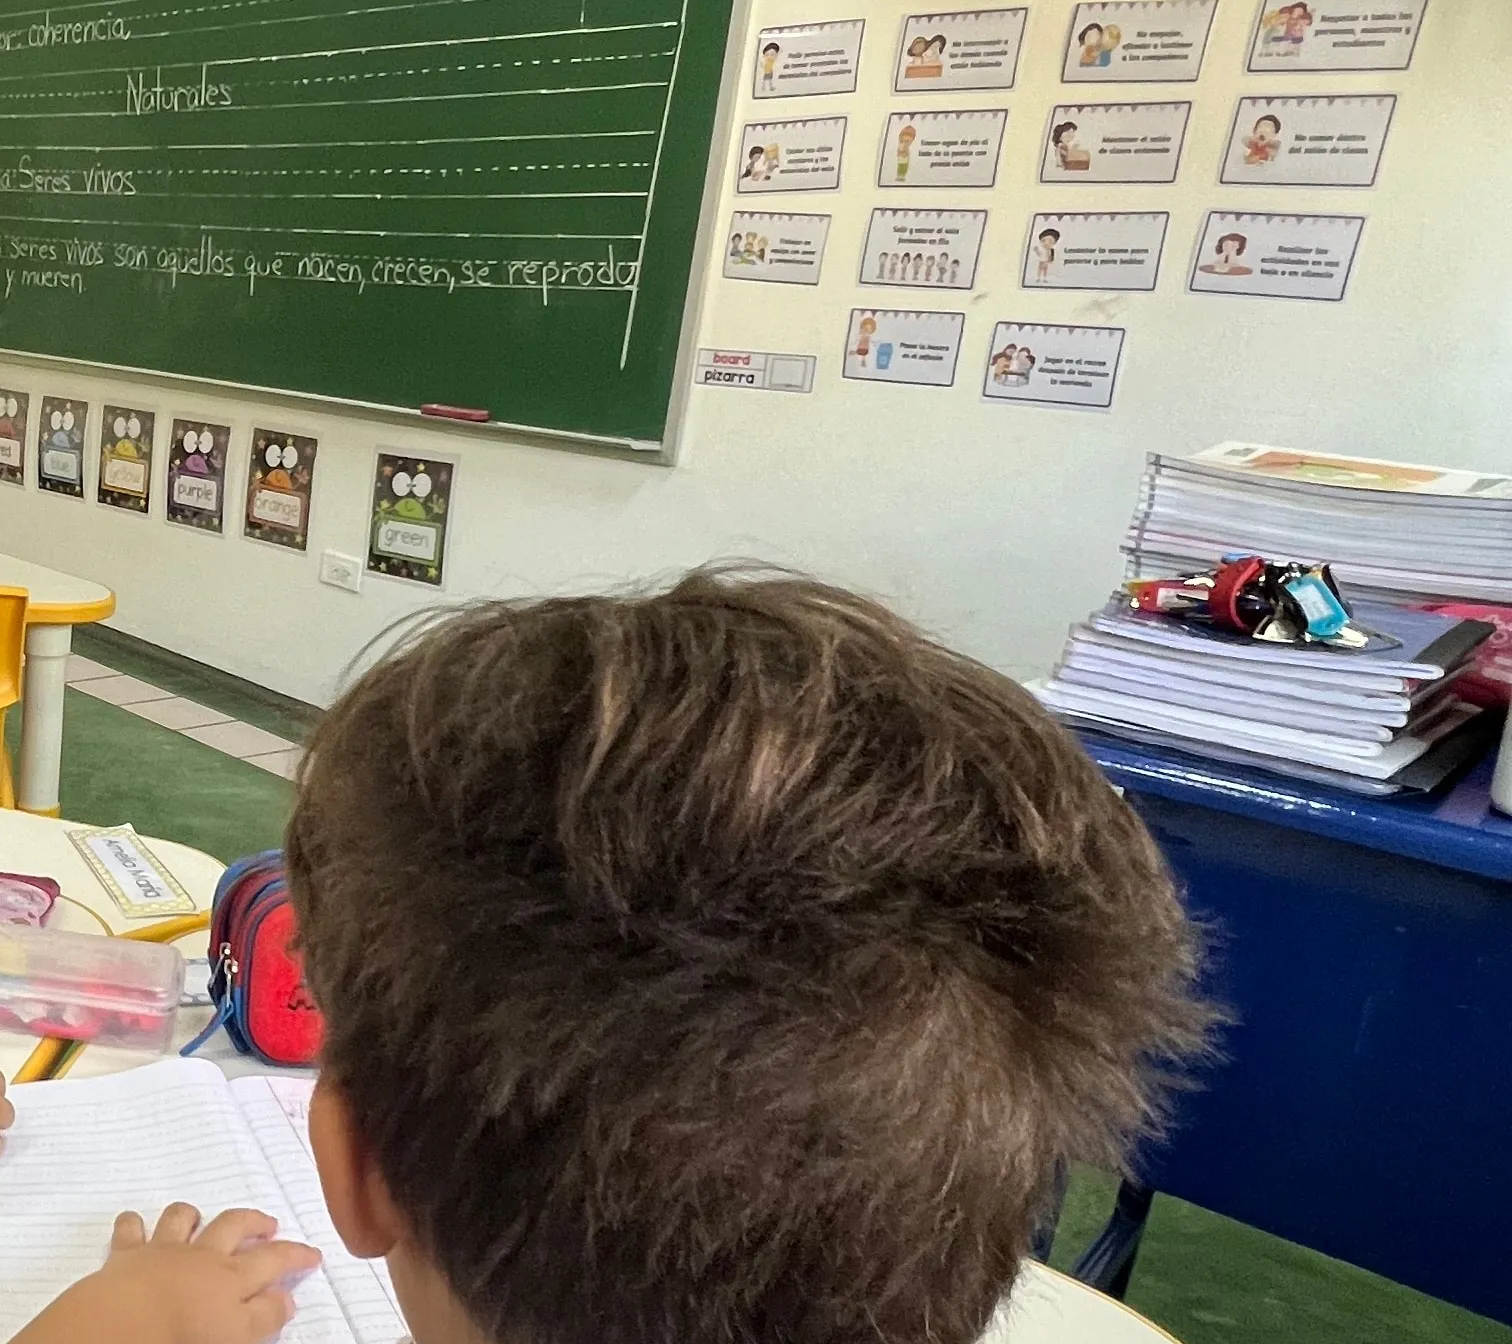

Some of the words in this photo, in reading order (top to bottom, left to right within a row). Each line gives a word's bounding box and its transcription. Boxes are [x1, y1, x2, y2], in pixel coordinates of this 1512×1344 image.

[28, 9, 131, 47] coherencia
[126, 63, 233, 115] Naturales
[19, 155, 71, 192] Seres
[10, 238, 57, 261] seres
[66, 237, 104, 266] vivos
[114, 243, 148, 269] son
[157, 235, 234, 289] aquellos
[244, 254, 282, 296] que
[372, 260, 455, 294] crecen,
[460, 261, 492, 285] se
[5, 268, 15, 299] y
[712, 353, 751, 365] board
[704, 369, 755, 384] pizarra
[177, 481, 214, 502] purple
[255, 495, 300, 521] orange
[384, 526, 430, 548] green
